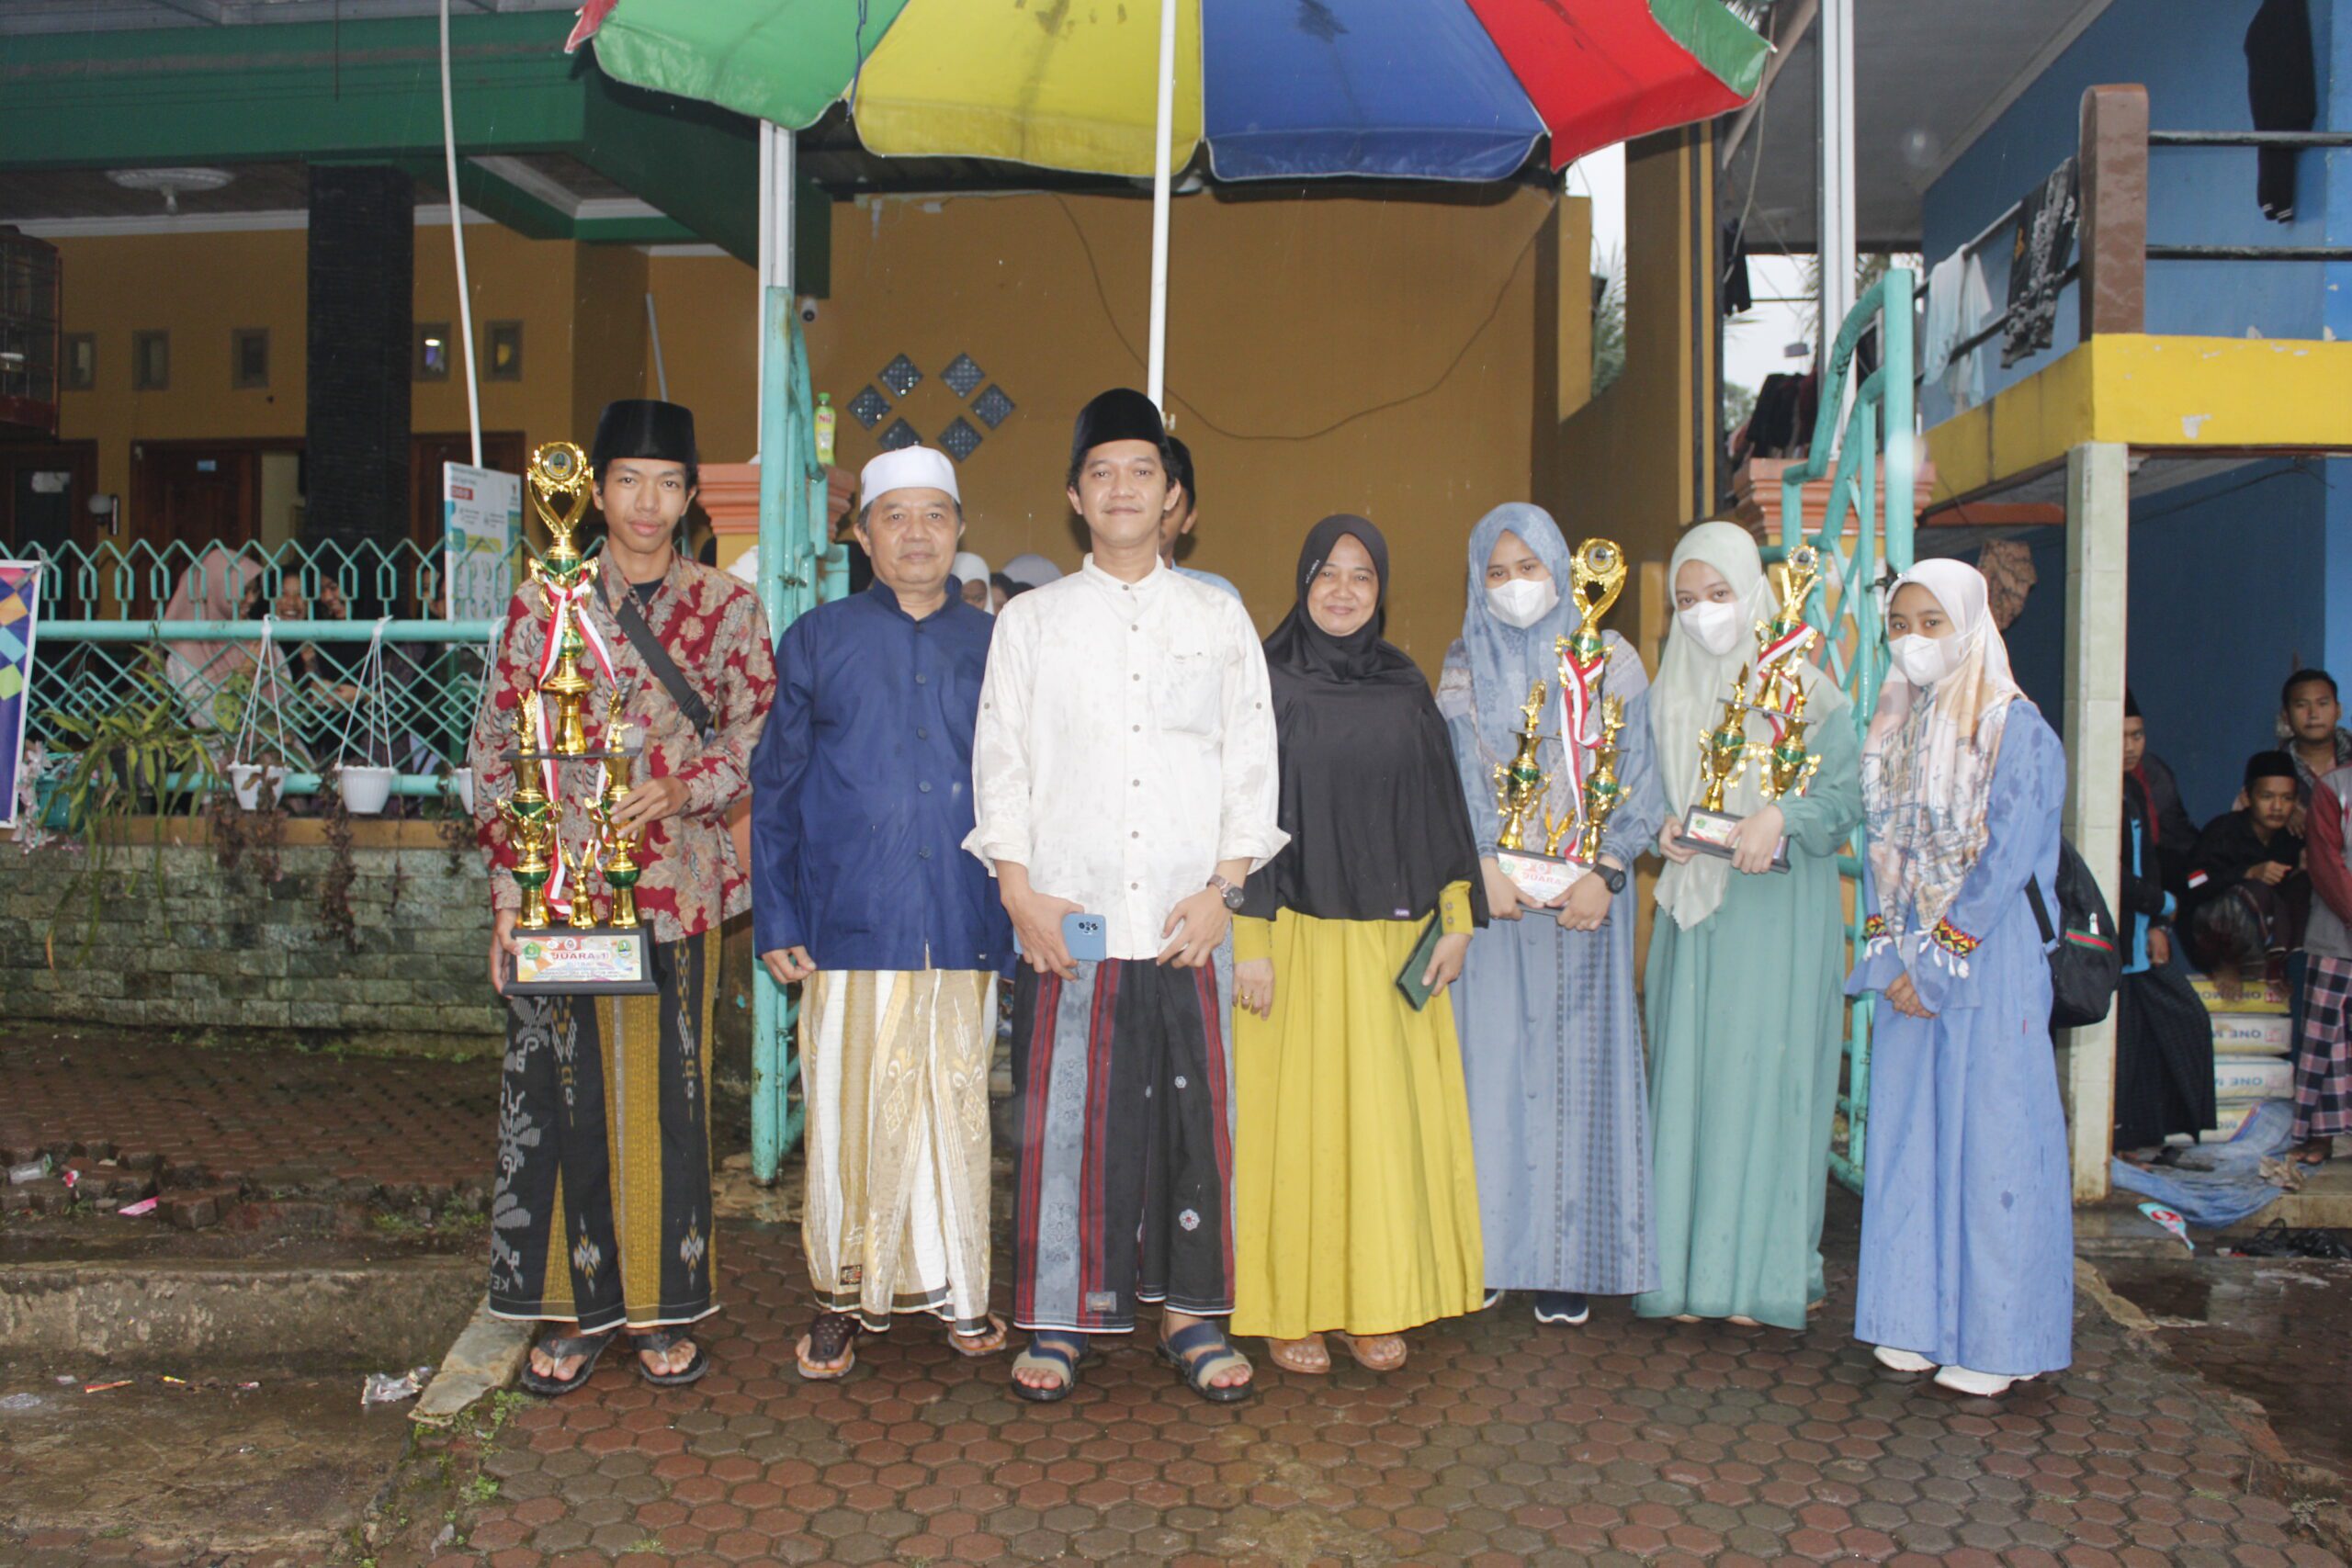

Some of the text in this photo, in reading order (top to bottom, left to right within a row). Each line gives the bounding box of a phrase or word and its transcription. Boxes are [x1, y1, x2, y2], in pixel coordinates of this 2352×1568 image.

[553, 952, 596, 960] JUARA
[2229, 1029, 2262, 1039] ONE
[2229, 1077, 2263, 1087] ONE
